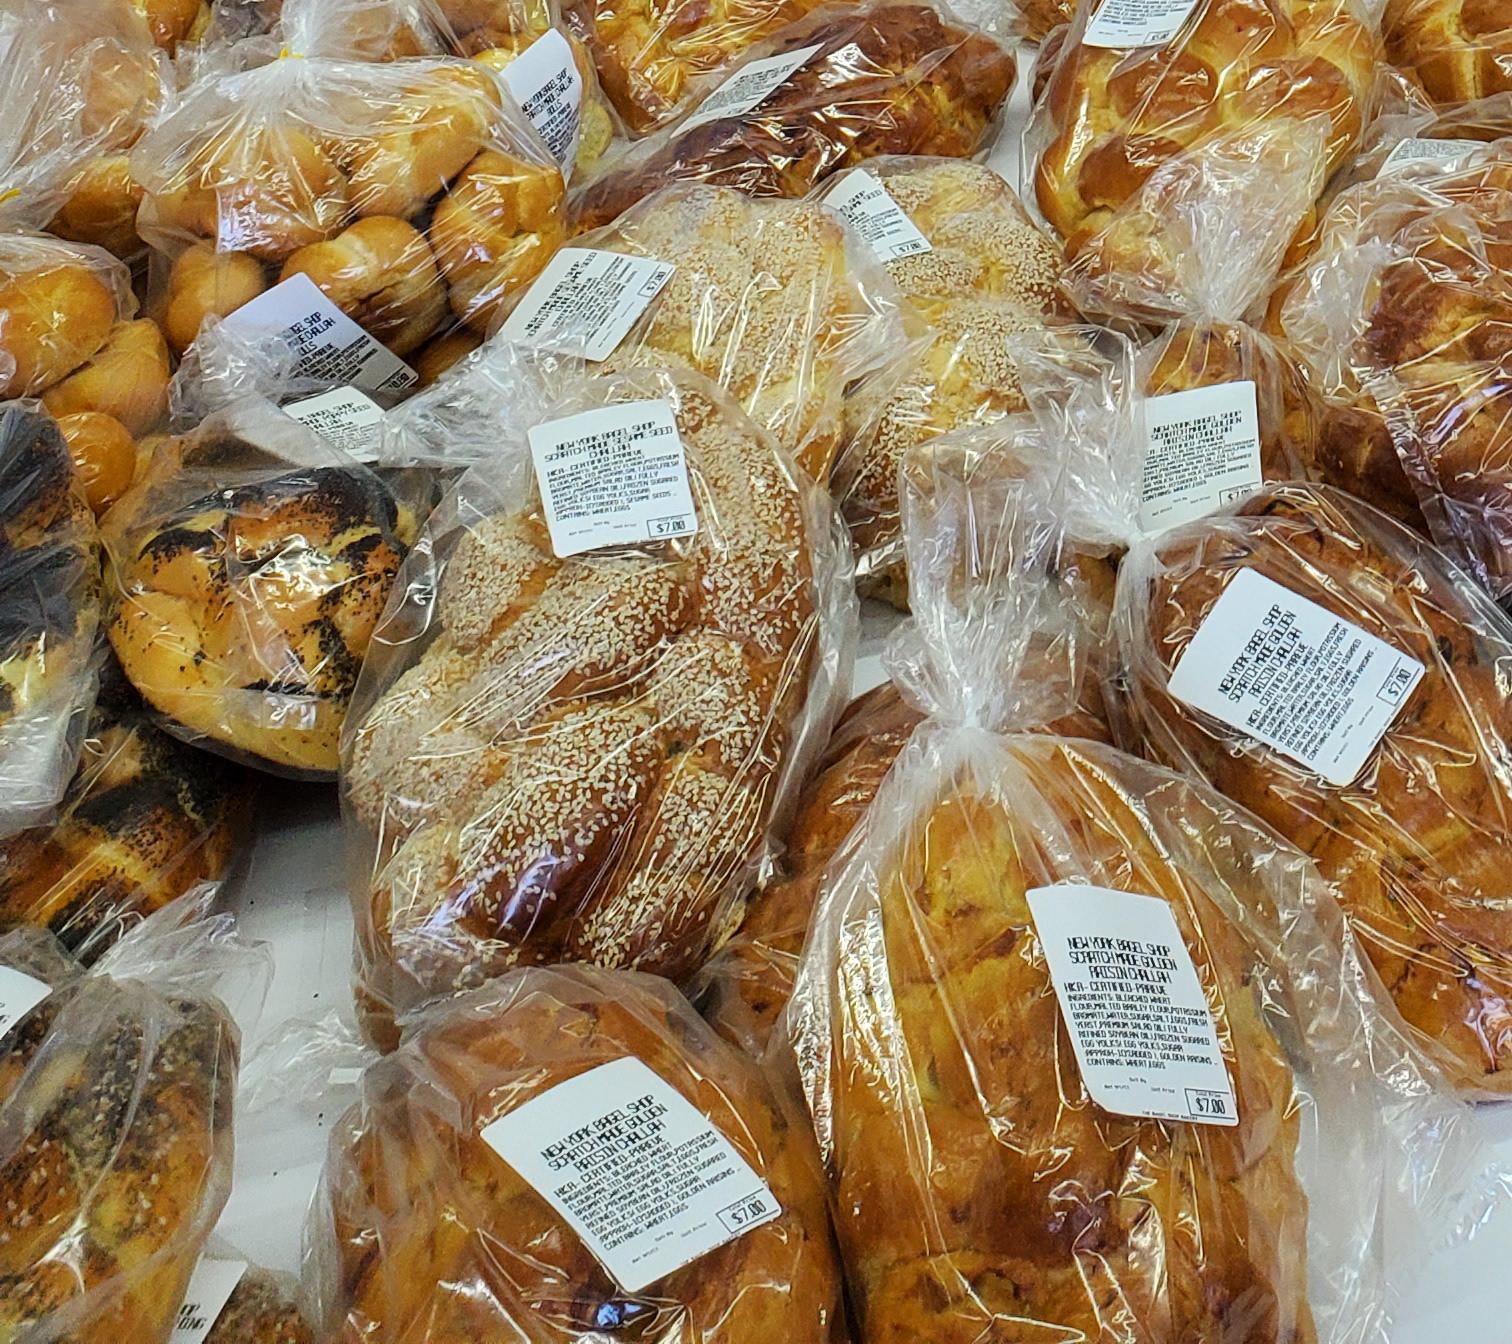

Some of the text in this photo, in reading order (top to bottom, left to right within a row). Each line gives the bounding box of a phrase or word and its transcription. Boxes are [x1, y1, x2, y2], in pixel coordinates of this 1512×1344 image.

[656, 521, 686, 533] $7.00
[1067, 937, 1170, 957] NEW YORK BAGEL SHOP
[1070, 952, 1115, 965] SCRATCH
[1140, 956, 1178, 971] GOLDEN
[1089, 965, 1128, 980] RAISIN
[1195, 1097, 1226, 1115] $7.00
[732, 1198, 768, 1226] $7.00
